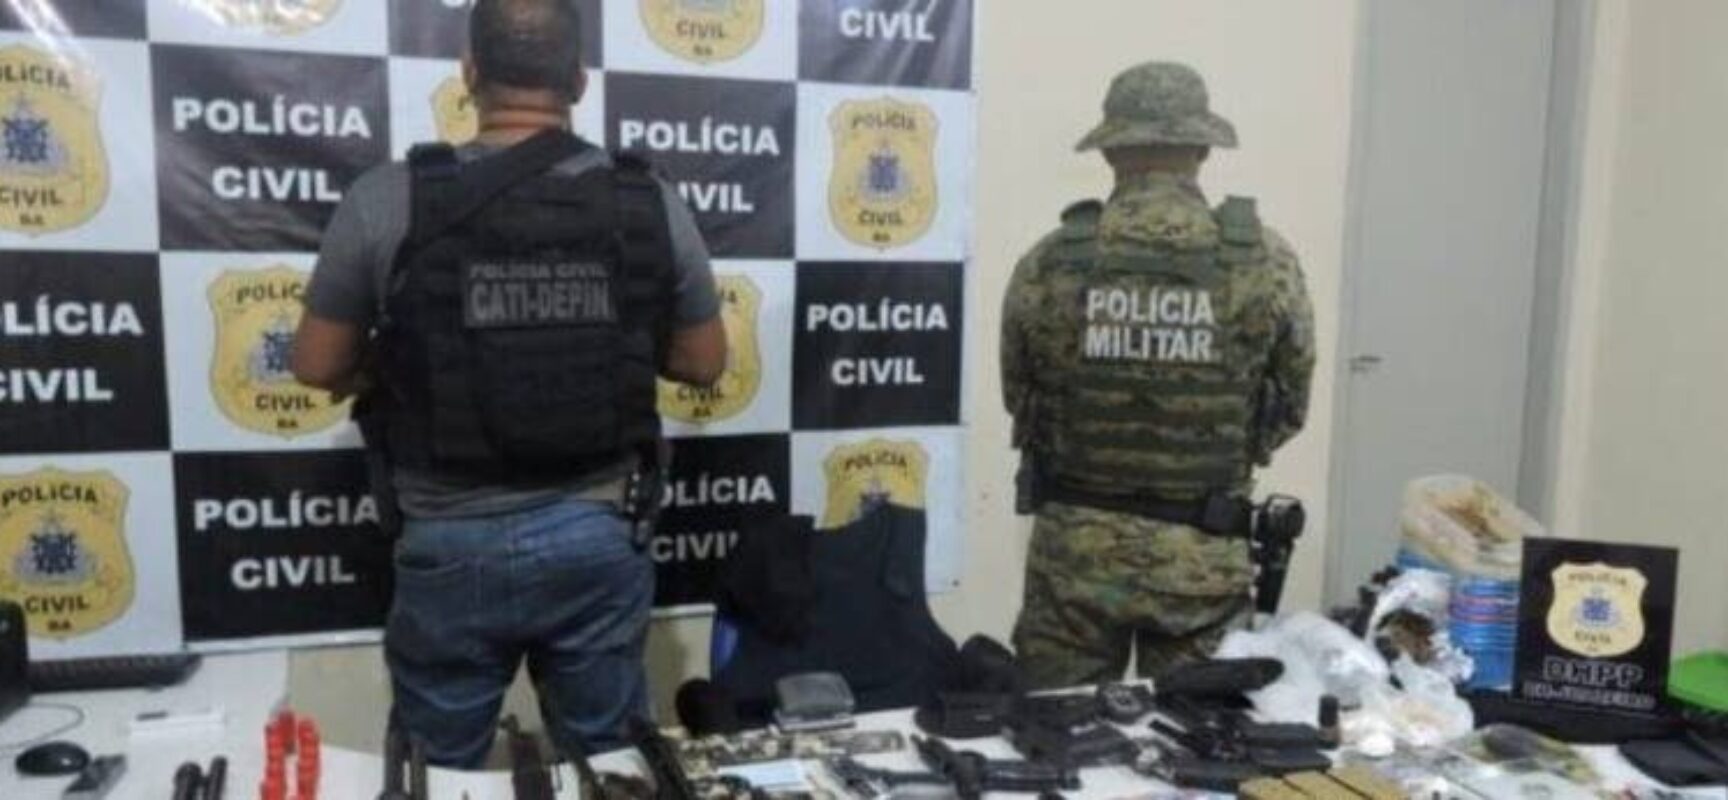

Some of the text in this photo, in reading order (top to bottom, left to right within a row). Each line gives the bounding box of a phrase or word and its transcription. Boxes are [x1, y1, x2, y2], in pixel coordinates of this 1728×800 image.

[676, 19, 726, 39] CIVIL
[838, 8, 935, 41] CIVIL
[171, 94, 371, 138] POLÍCIA
[619, 116, 780, 155] POLÍCIA
[211, 166, 343, 202] CIVIL
[858, 209, 903, 226] CIVIL
[0, 294, 144, 336] LÍCIA
[807, 297, 948, 331] POLÍCIA
[1086, 324, 1214, 361] MILITAR
[831, 358, 924, 385] CIVIL
[255, 395, 316, 411] CIVIL
[194, 490, 380, 530] POLÍCIA
[231, 557, 355, 589] CIVIL
[25, 597, 91, 613] CIVIL
[1543, 655, 1644, 689] DHPP
